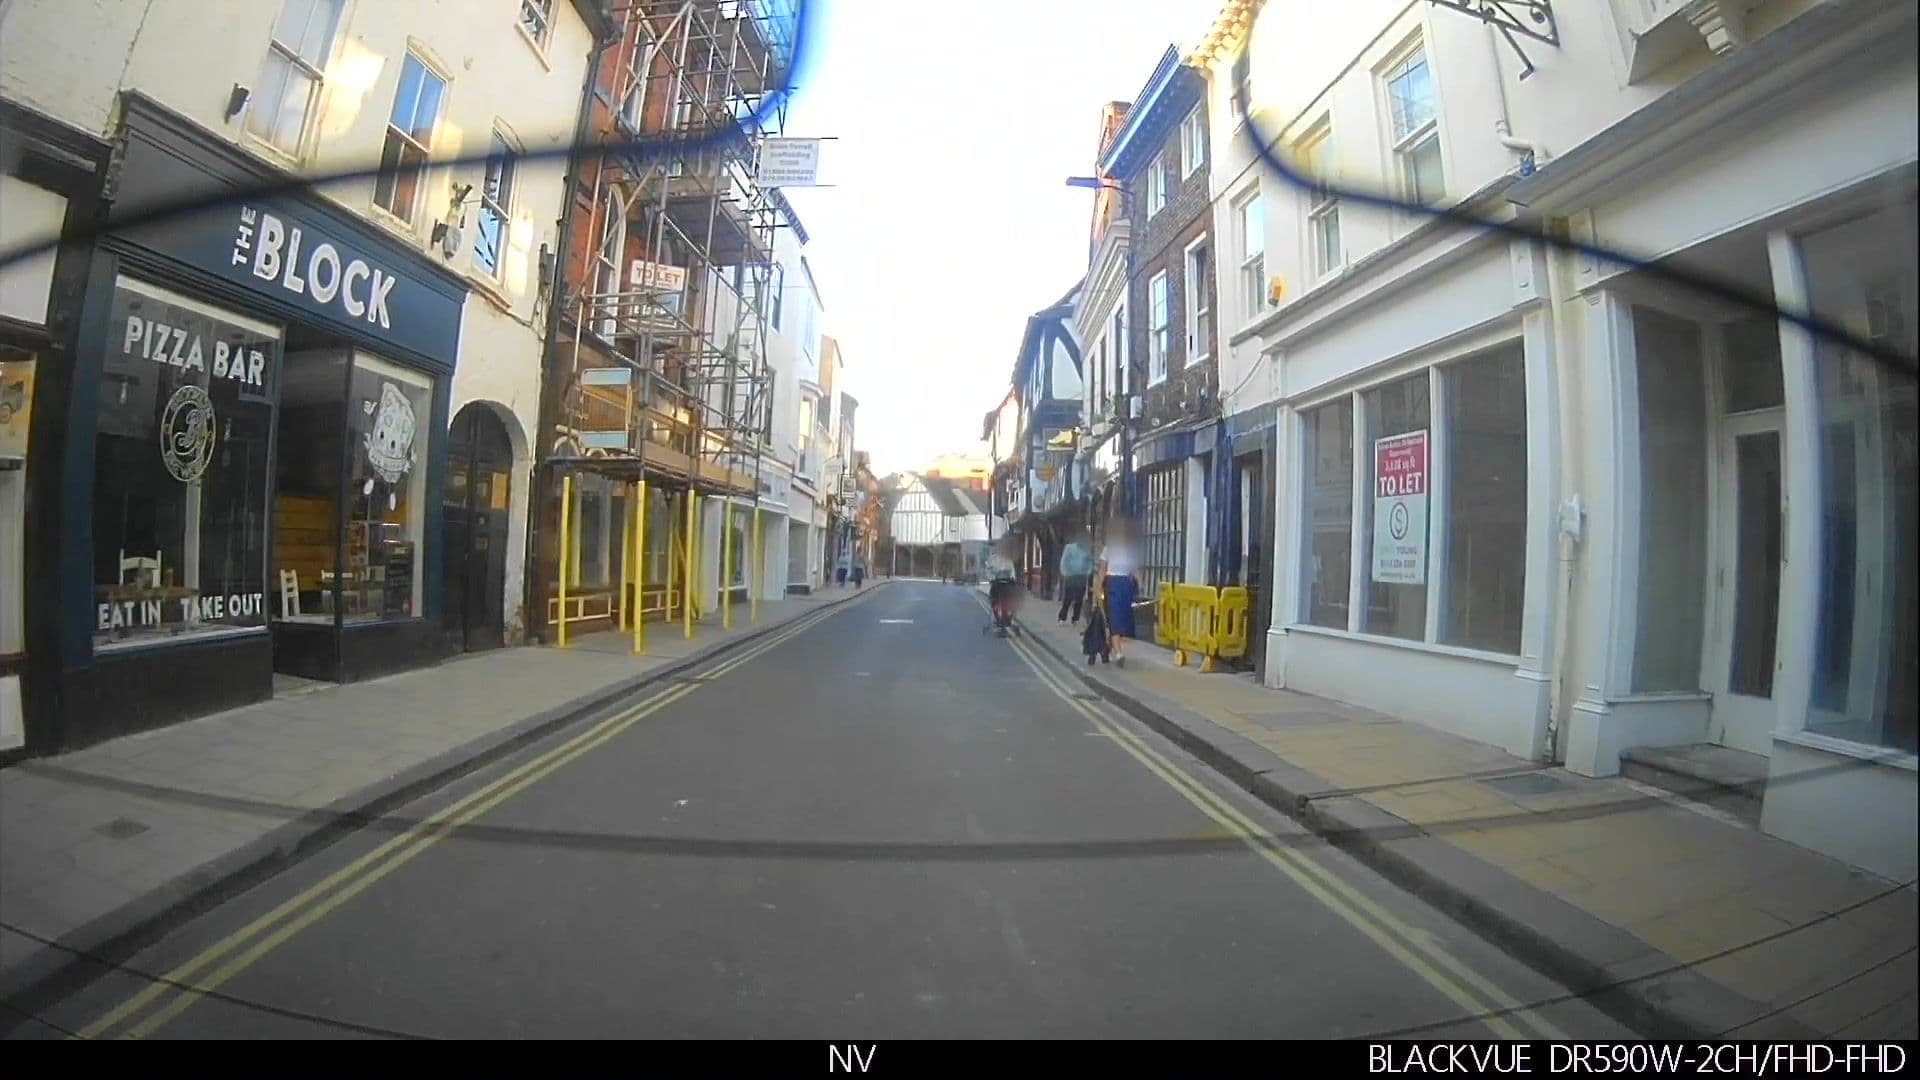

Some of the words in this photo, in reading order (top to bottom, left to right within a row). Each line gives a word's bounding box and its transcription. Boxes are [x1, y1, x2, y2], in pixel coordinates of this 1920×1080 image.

[231, 205, 257, 266] THE
[253, 213, 396, 329] BLOCK
[123, 315, 205, 373] PIZZA
[213, 340, 265, 387] BAR
[1379, 475, 1396, 496] TO
[1399, 471, 1422, 494] LET
[98, 602, 135, 629] EAT
[140, 600, 161, 625] IN
[180, 595, 224, 625] TAKE
[229, 593, 262, 617] OUT
